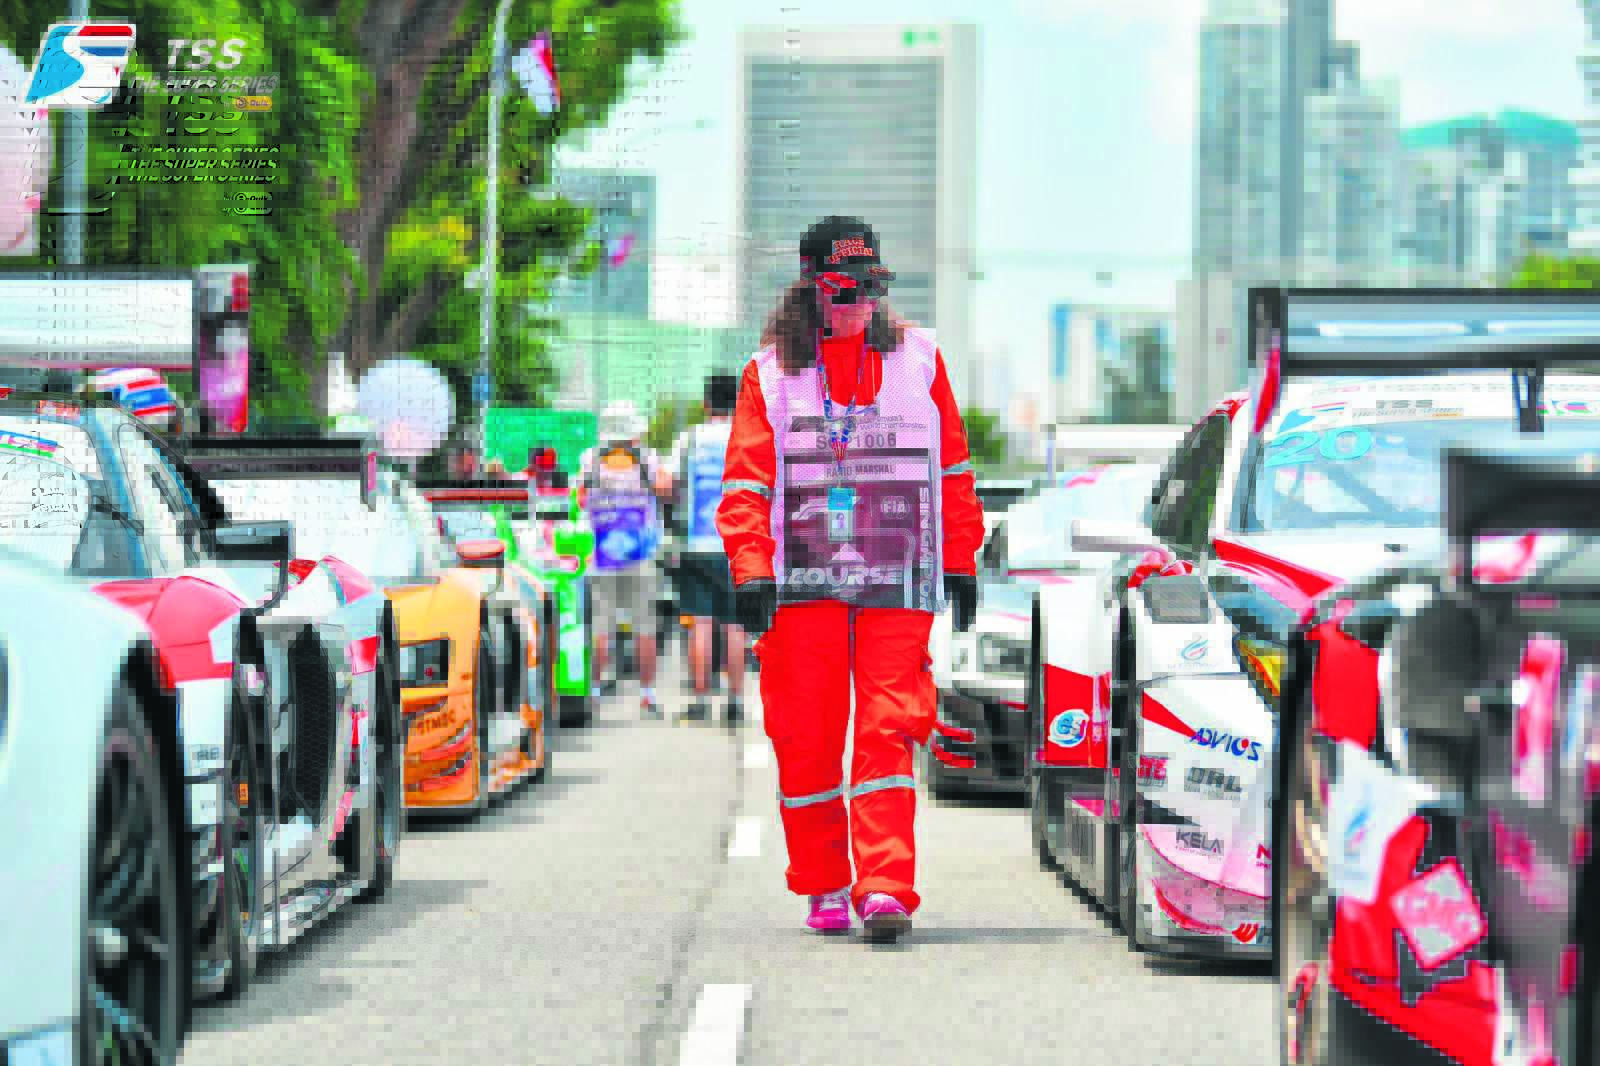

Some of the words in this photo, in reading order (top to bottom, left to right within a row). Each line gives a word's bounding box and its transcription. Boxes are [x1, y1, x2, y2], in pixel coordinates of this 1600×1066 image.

[1265, 427, 1375, 468] 20
[787, 564, 904, 590] COURSE
[1189, 727, 1263, 762] ADVICS
[1176, 829, 1222, 854] KELA
